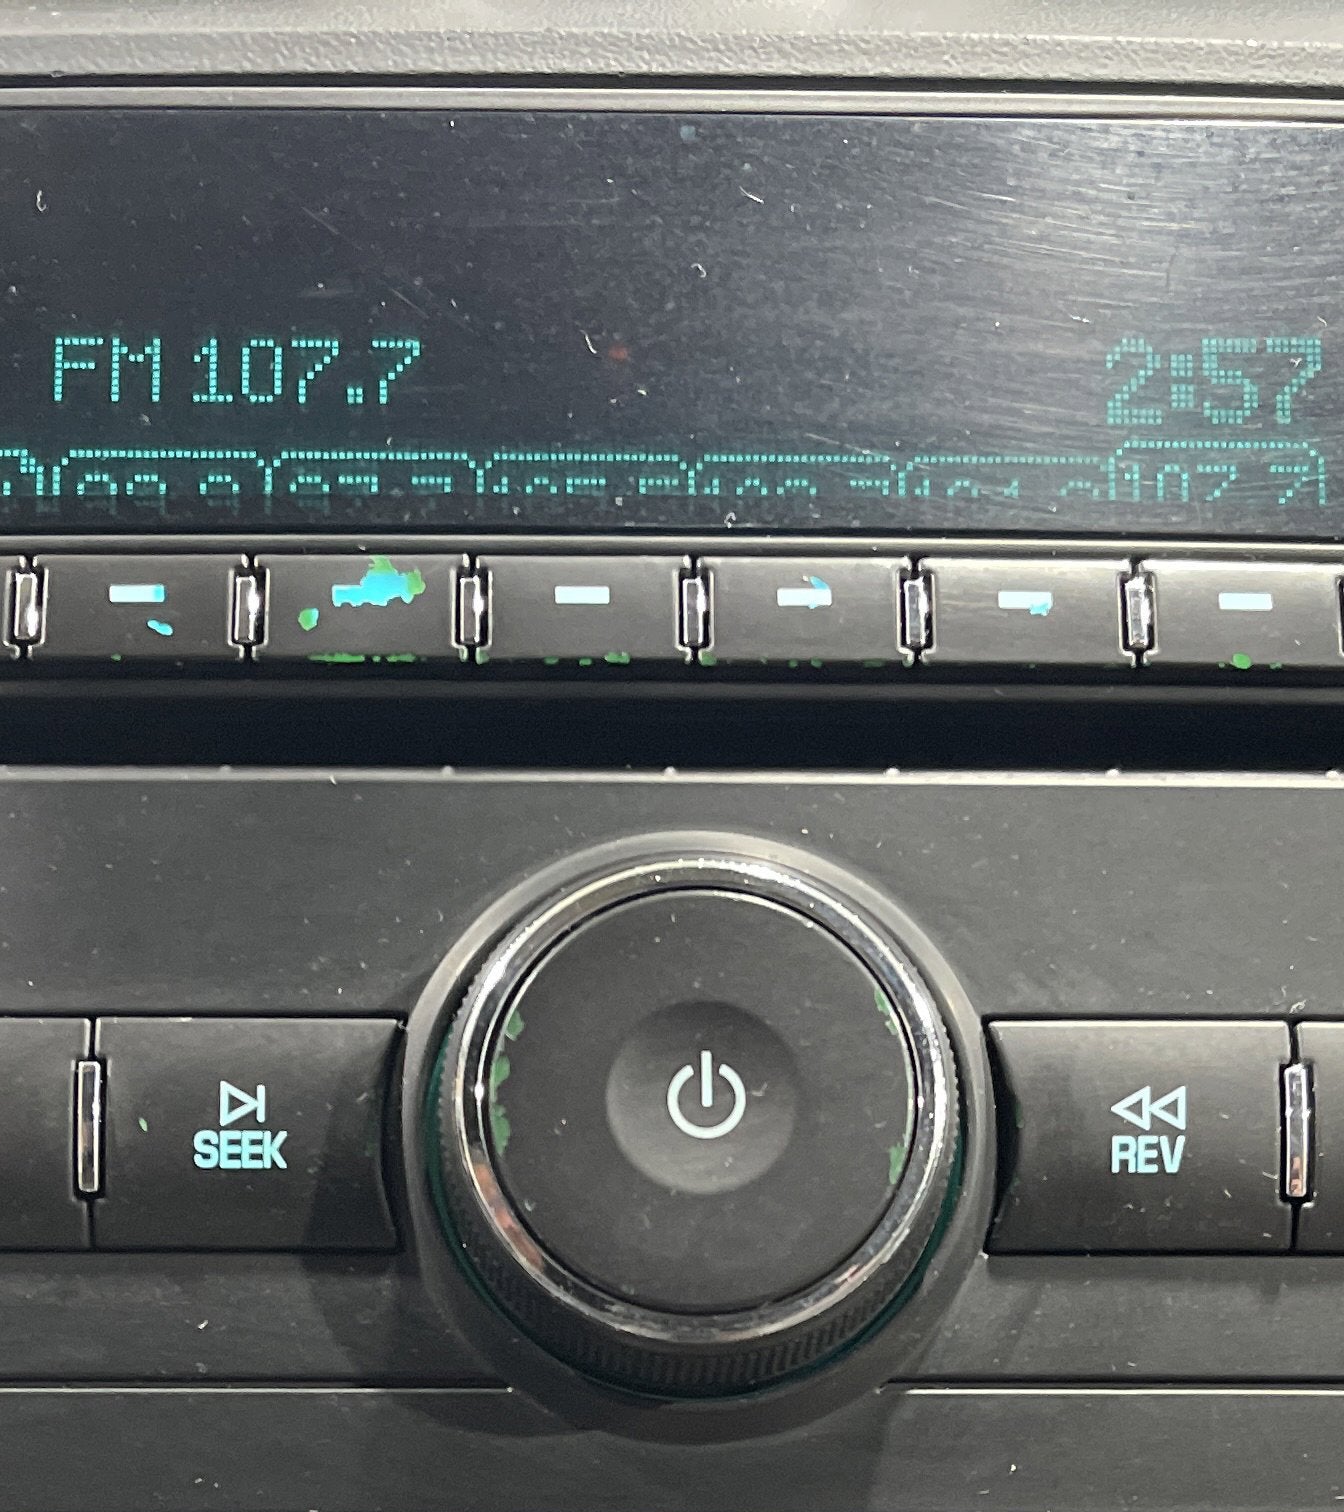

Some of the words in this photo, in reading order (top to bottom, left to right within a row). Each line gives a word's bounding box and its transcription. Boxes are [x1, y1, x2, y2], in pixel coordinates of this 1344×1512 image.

[53, 336, 161, 403] FM
[192, 337, 421, 405] 107.7
[1106, 337, 1322, 425] 2:57
[193, 1129, 288, 1169] SEEK
[1111, 1134, 1186, 1174] REV
